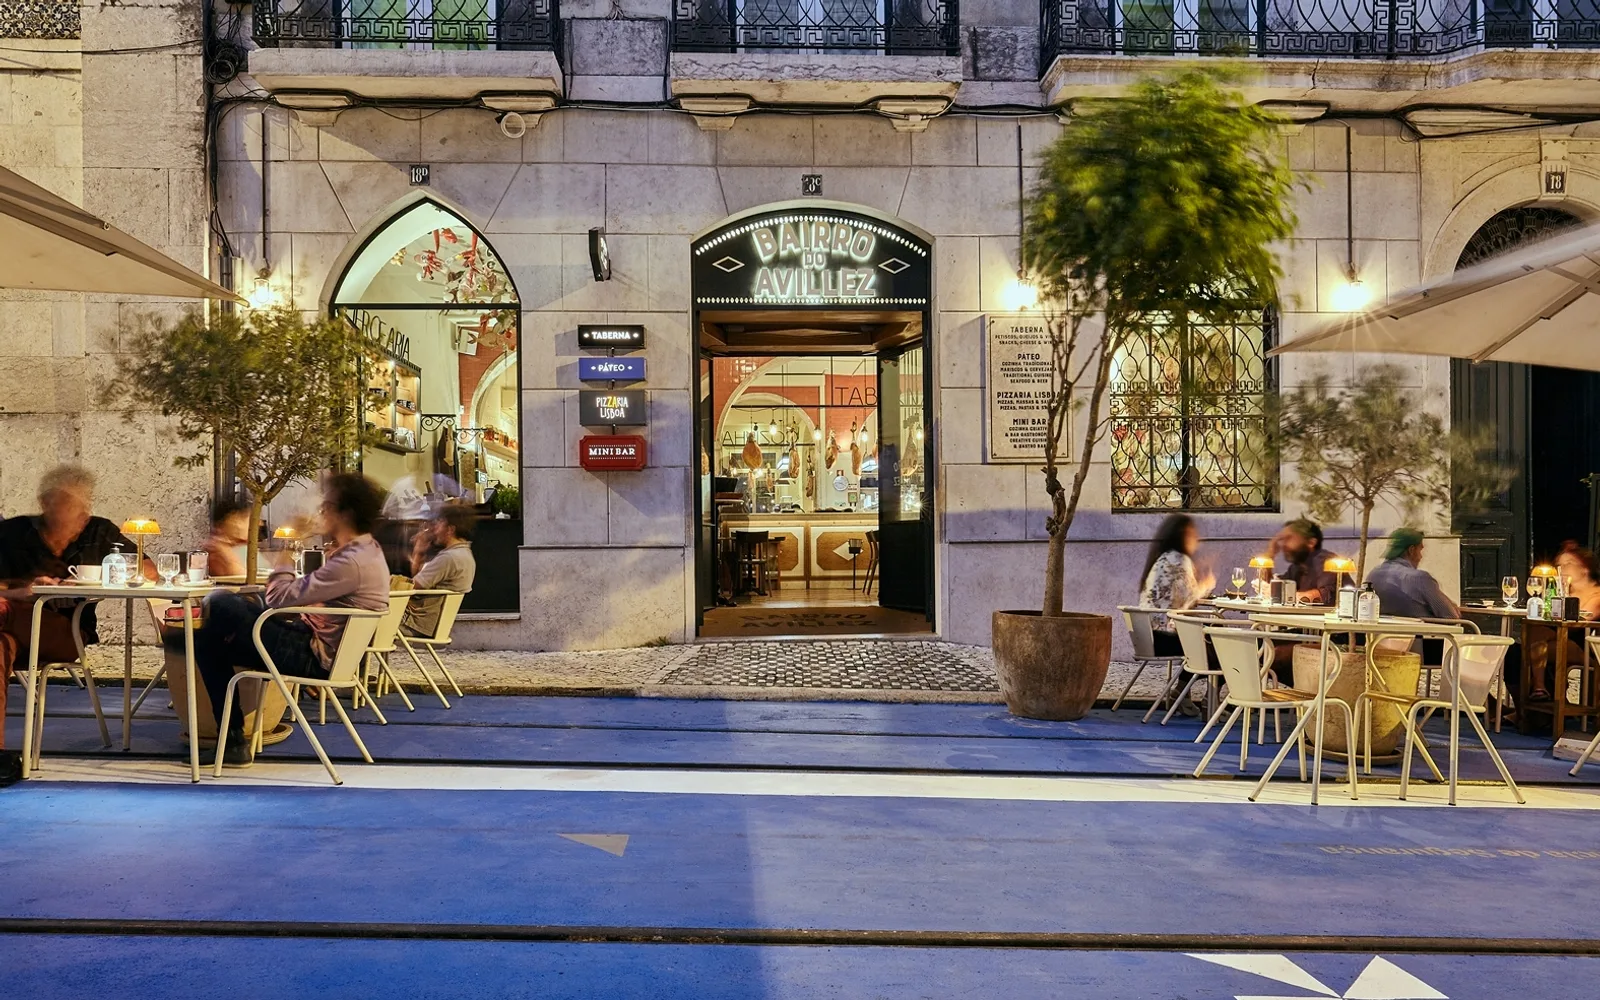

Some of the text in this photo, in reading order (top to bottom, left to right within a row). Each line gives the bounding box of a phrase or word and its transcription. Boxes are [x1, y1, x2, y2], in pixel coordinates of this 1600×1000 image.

[1550, 174, 1562, 190] 18
[752, 220, 876, 262] BAIRRO
[803, 251, 827, 269] DO
[754, 266, 877, 298] AVILLEZ
[352, 308, 410, 361] ERCEARIA
[591, 331, 631, 340] TABERNA
[598, 362, 625, 372] PÁTEO
[996, 391, 1032, 399] PIZZARIA
[596, 396, 629, 408] PIZZARIA
[600, 407, 626, 419] LISBOA
[589, 448, 636, 456] MINI BAR
